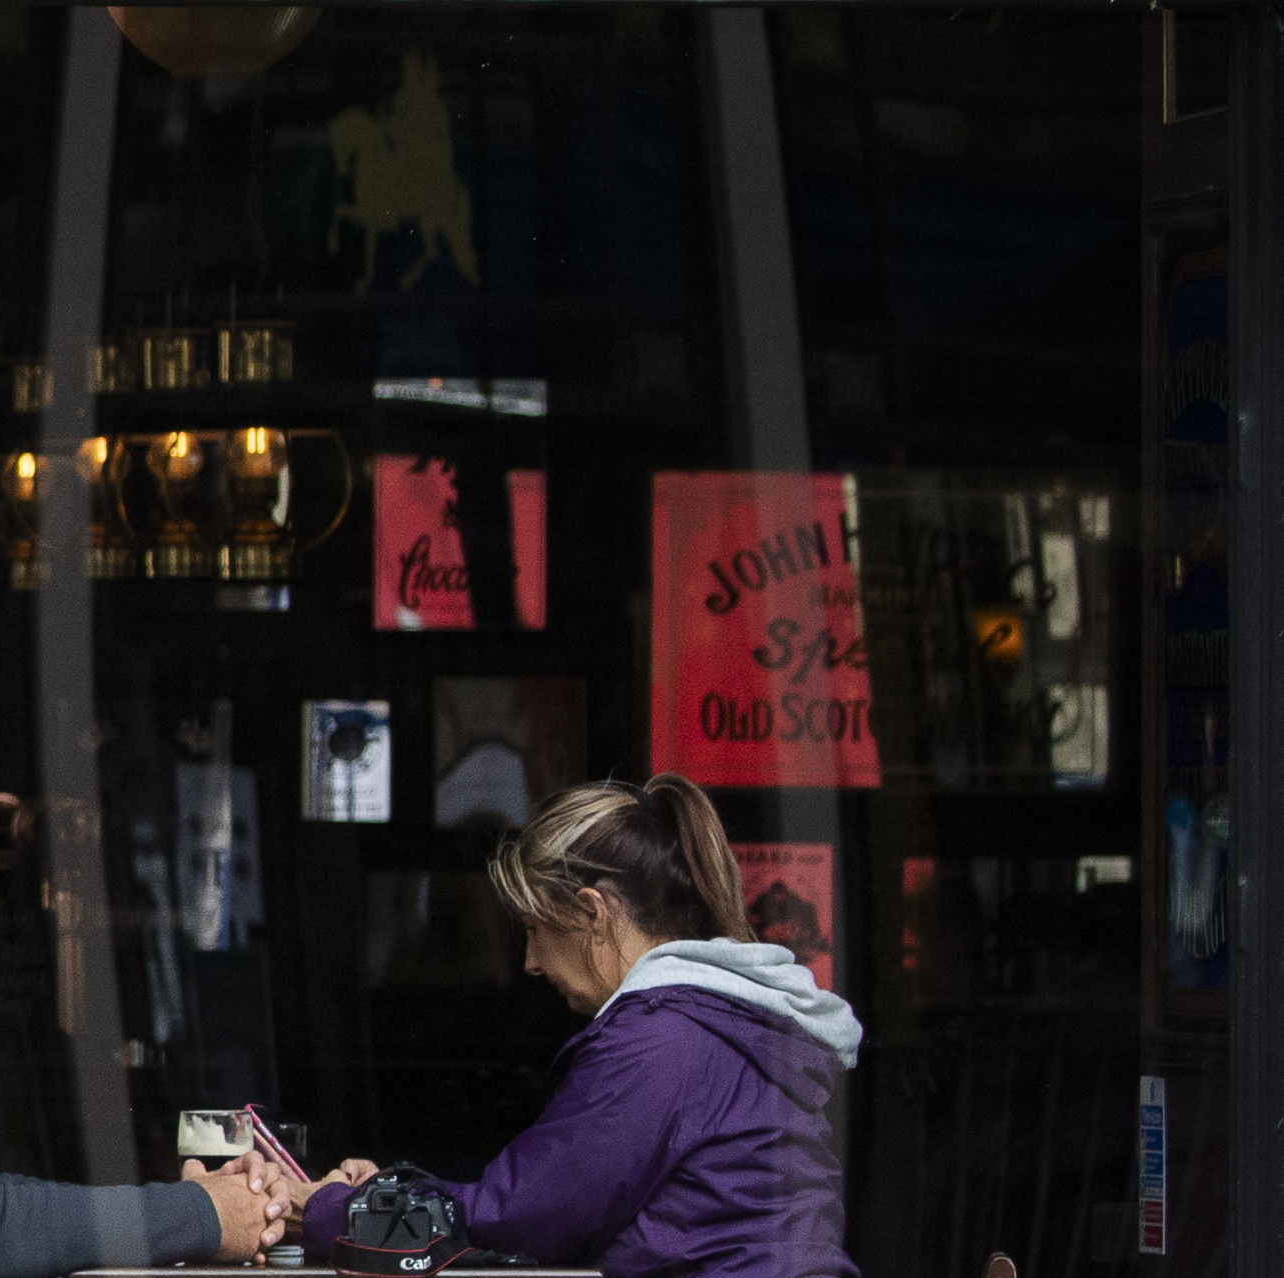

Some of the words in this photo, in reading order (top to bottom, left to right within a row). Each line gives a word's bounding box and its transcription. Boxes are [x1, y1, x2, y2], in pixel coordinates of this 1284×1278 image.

[704, 521, 830, 616] JOHN
[751, 617, 870, 684] Spe
[701, 691, 775, 743] OLD
[779, 692, 870, 744] SCOT
[399, 1255, 433, 1271] Can
